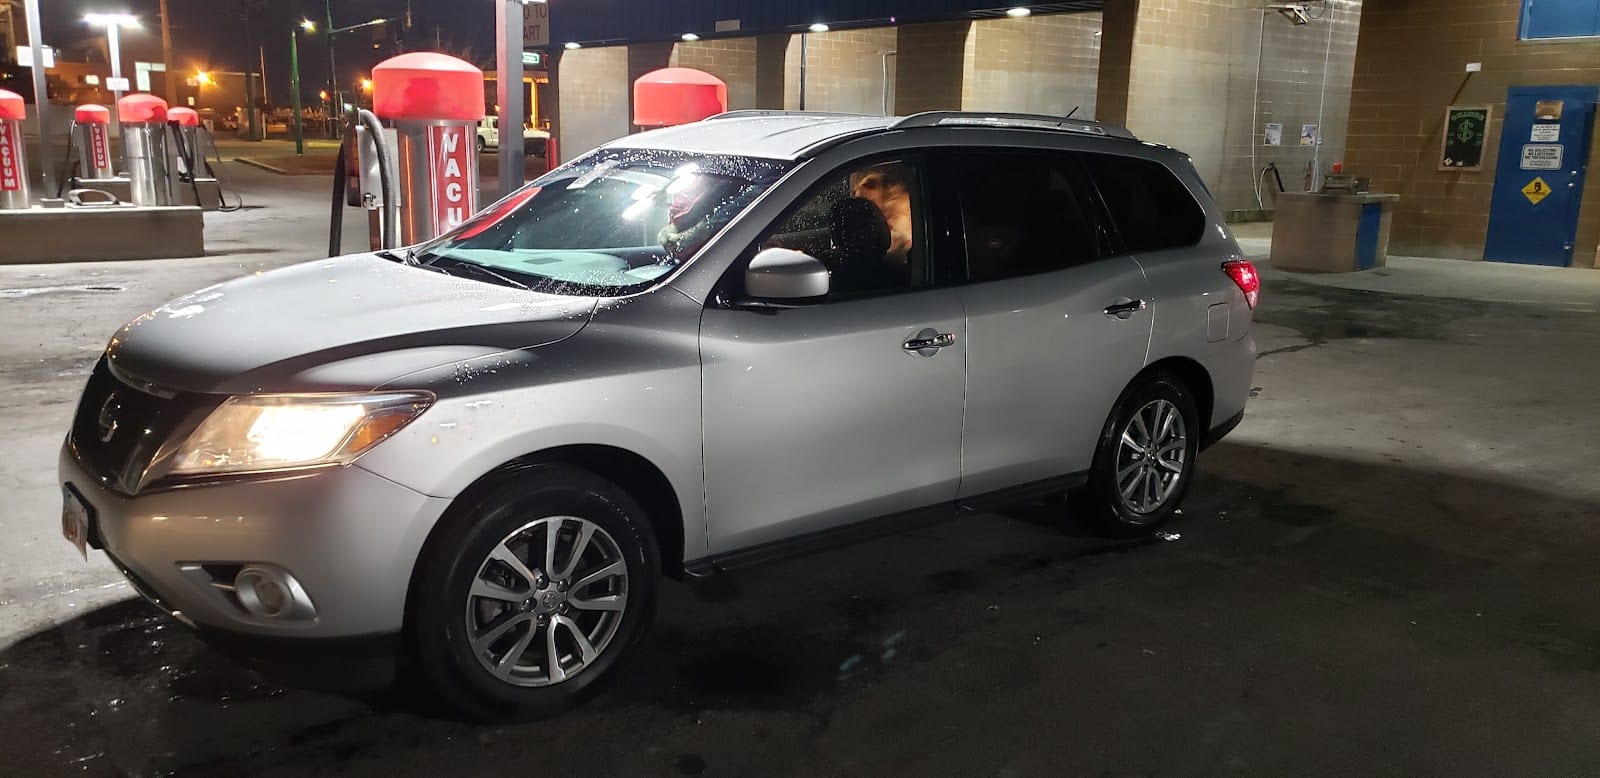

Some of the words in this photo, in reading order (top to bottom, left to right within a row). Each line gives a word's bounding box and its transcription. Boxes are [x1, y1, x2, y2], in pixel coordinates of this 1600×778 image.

[535, 4, 547, 18] TO
[523, 25, 541, 40] ART
[0, 125, 15, 187] VACUUM
[95, 127, 105, 166] VACUUM
[443, 133, 463, 226] VACU
